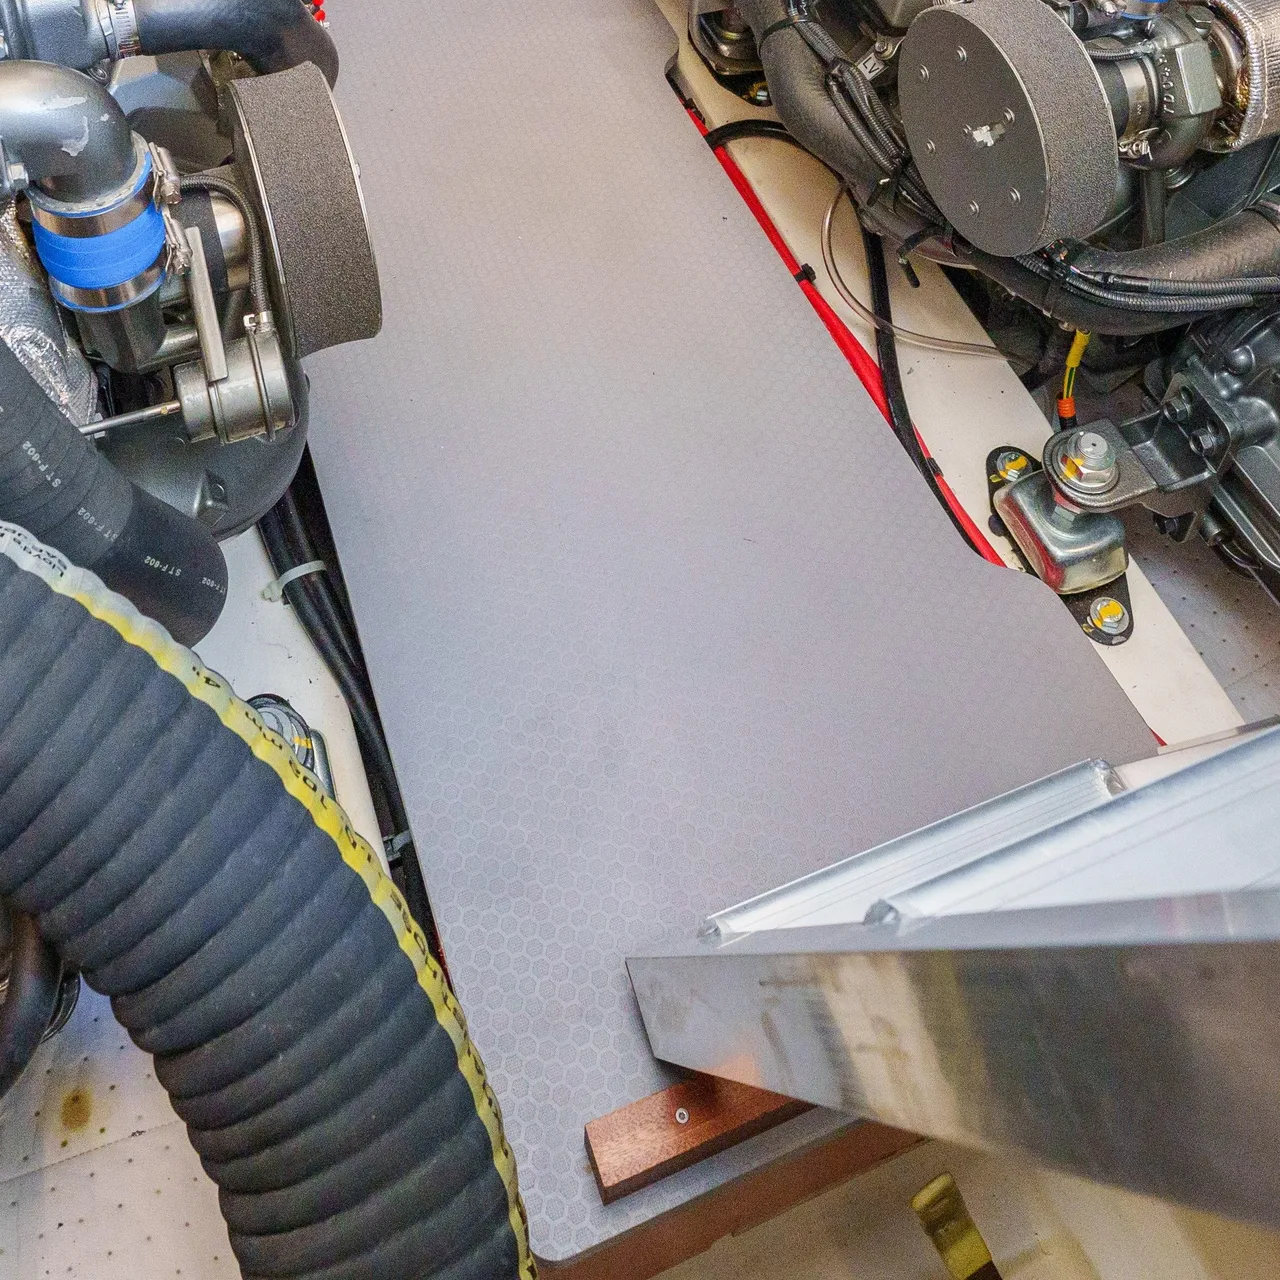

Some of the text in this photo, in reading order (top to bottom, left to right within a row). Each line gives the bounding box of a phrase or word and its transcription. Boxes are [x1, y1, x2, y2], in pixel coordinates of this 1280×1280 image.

[863, 56, 880, 74] LV
[13, 537, 64, 577] Lloyd's
[287, 756, 328, 808] 102
